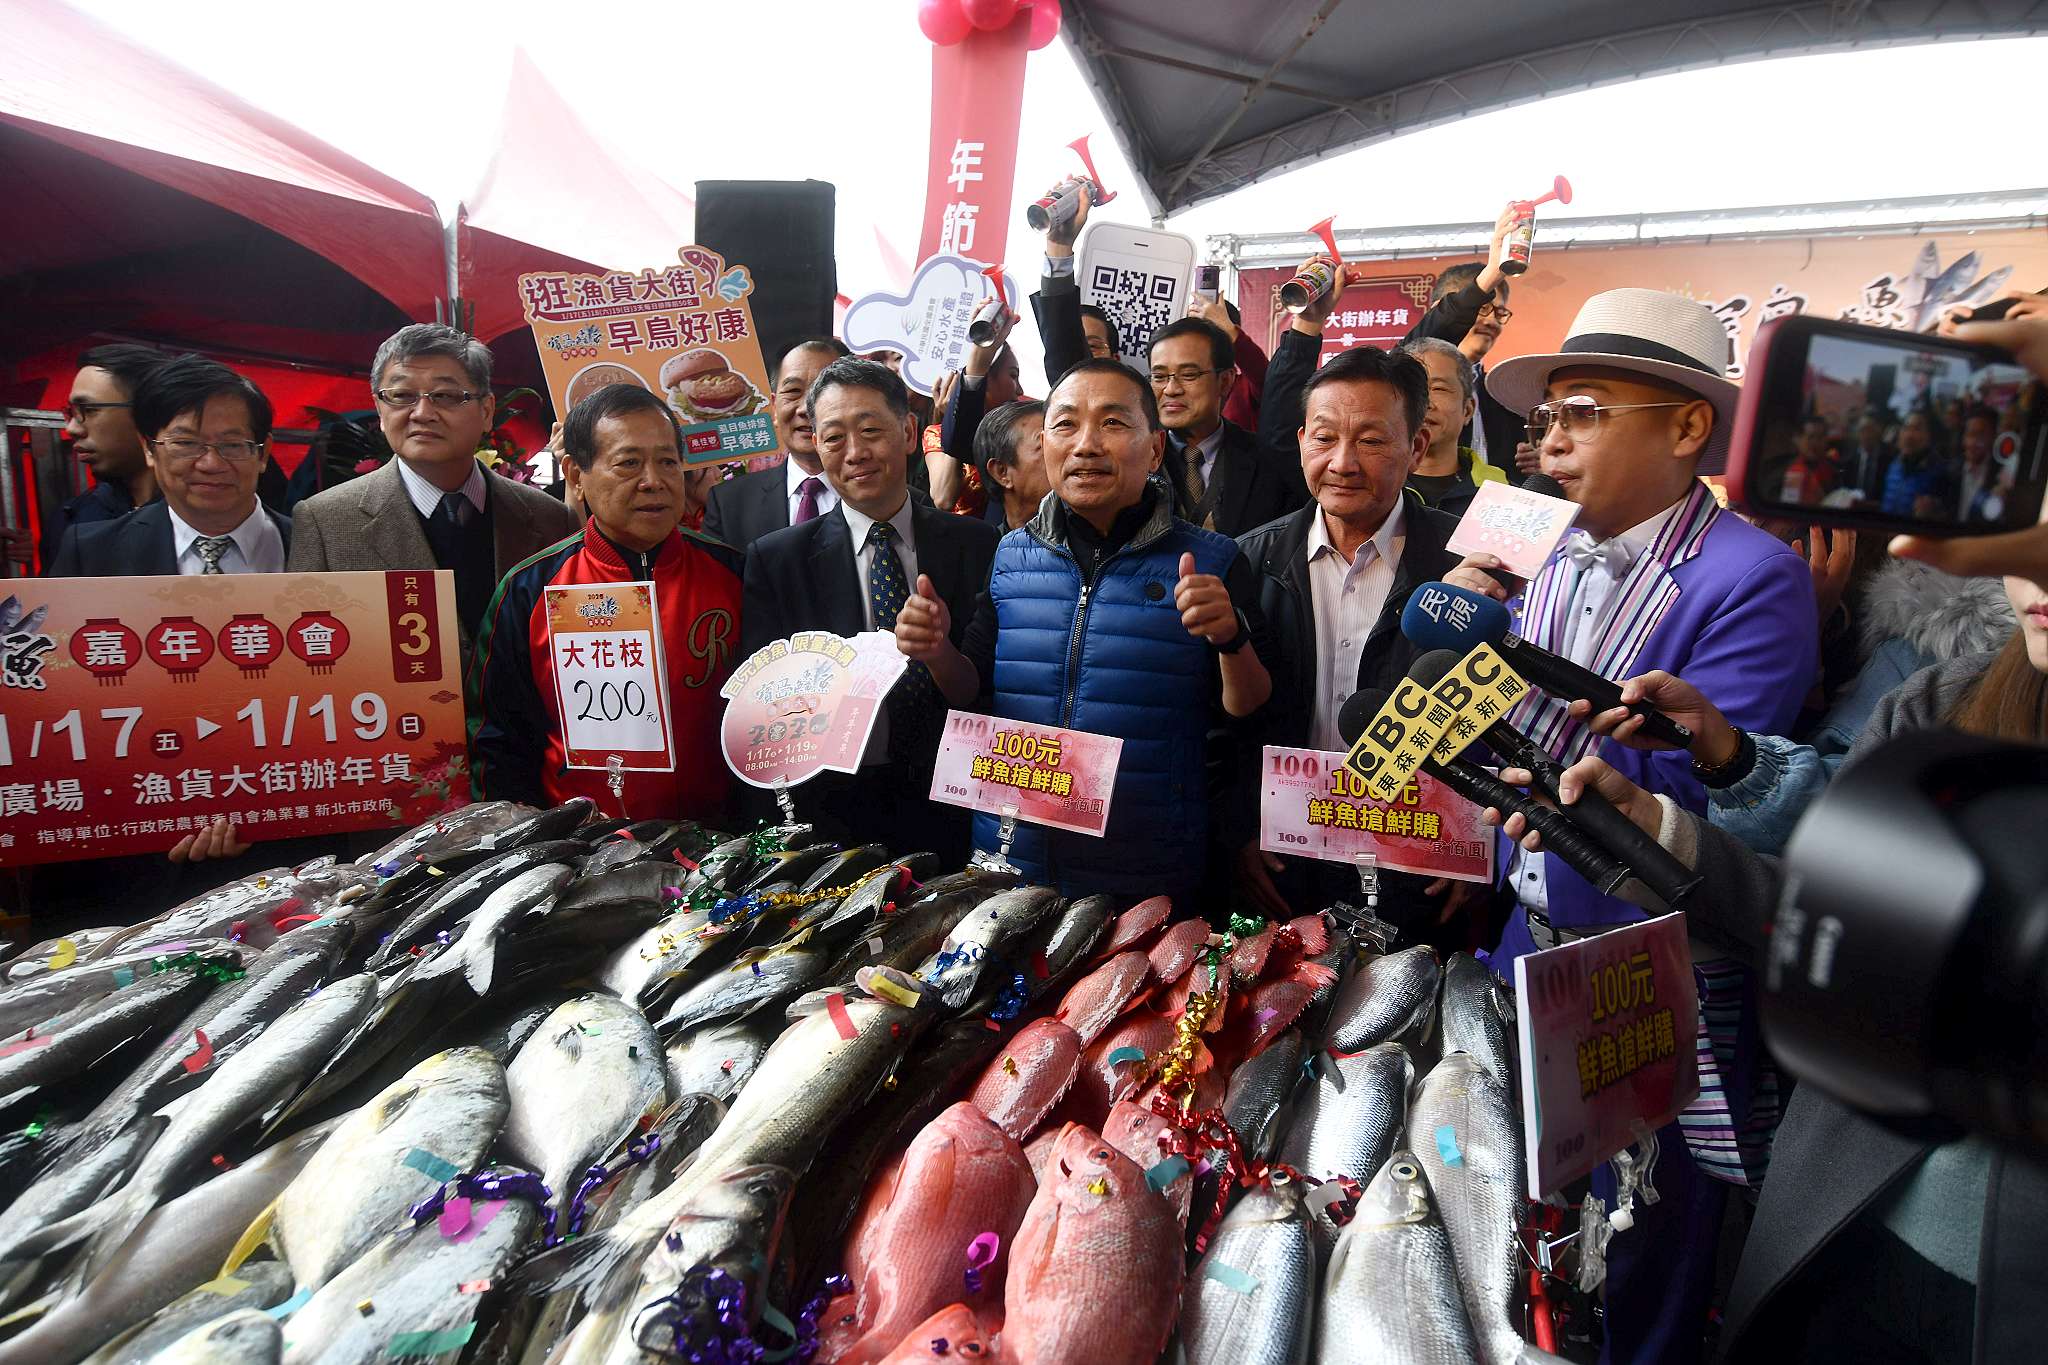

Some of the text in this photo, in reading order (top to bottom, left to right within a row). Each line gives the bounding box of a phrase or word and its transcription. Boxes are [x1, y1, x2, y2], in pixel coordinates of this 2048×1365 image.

[938, 139, 984, 255] 年節
[525, 270, 695, 319] 逛漁貨大街
[608, 308, 748, 353] 早鳥好康
[931, 296, 957, 360] 安心水產
[1324, 309, 1409, 328] 大街辦年貨
[722, 430, 771, 452] 早餐券
[398, 576, 431, 674] 只有3天
[1418, 587, 1479, 633] 民視
[82, 621, 336, 667] 嘉年華會
[562, 638, 646, 670] 大花枝
[723, 642, 788, 697] 百元鮮魚
[1432, 651, 1501, 713] BC
[155, 732, 181, 752] 五
[236, 691, 389, 748] 1/19
[400, 716, 420, 735] 日
[953, 716, 988, 738] 100
[1436, 675, 1524, 760] 東森新聞
[991, 731, 1062, 767] 100元
[1271, 754, 1319, 779] 100
[1376, 703, 1452, 797] 東森新聞
[943, 784, 967, 796] 100
[970, 755, 1073, 797] 鮮魚搶鮮購
[315, 797, 393, 818] 新北市政府
[1307, 800, 1440, 839] 鮮魚搶鮮購
[1278, 832, 1308, 845] 100
[1590, 952, 1655, 1022] 100元
[1577, 1008, 1675, 1097] 鮮魚搶鮮購
